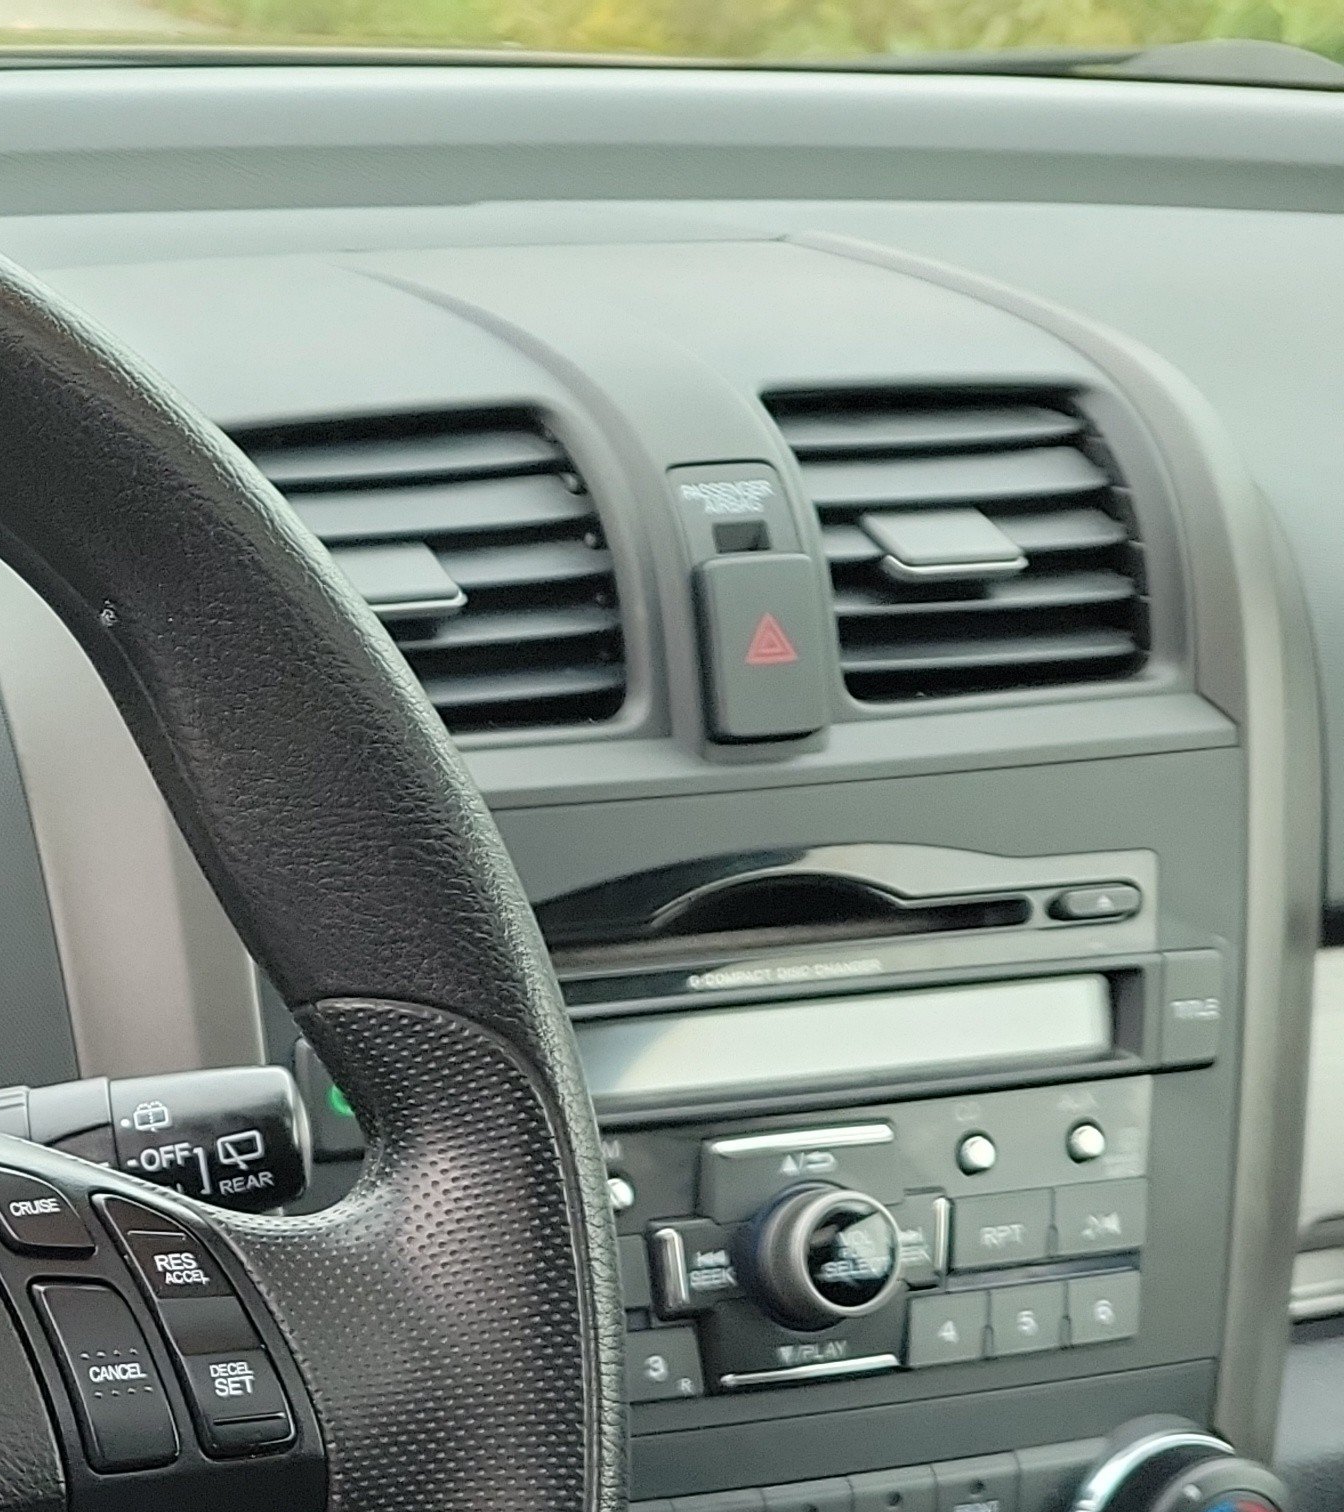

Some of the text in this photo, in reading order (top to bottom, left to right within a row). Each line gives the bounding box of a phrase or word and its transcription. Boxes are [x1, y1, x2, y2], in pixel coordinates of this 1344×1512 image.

[140, 1142, 192, 1171] OFF
[219, 1170, 274, 1196] REAR
[9, 1197, 62, 1218] CRUISE
[154, 1251, 197, 1272] RES
[164, 1269, 210, 1286] ACCEL
[938, 1318, 960, 1344] 4
[1018, 1309, 1039, 1336] 5
[89, 1362, 148, 1382] CANCEL
[209, 1362, 254, 1379] DECEL
[644, 1354, 669, 1382] 3
[214, 1376, 255, 1396] SET
